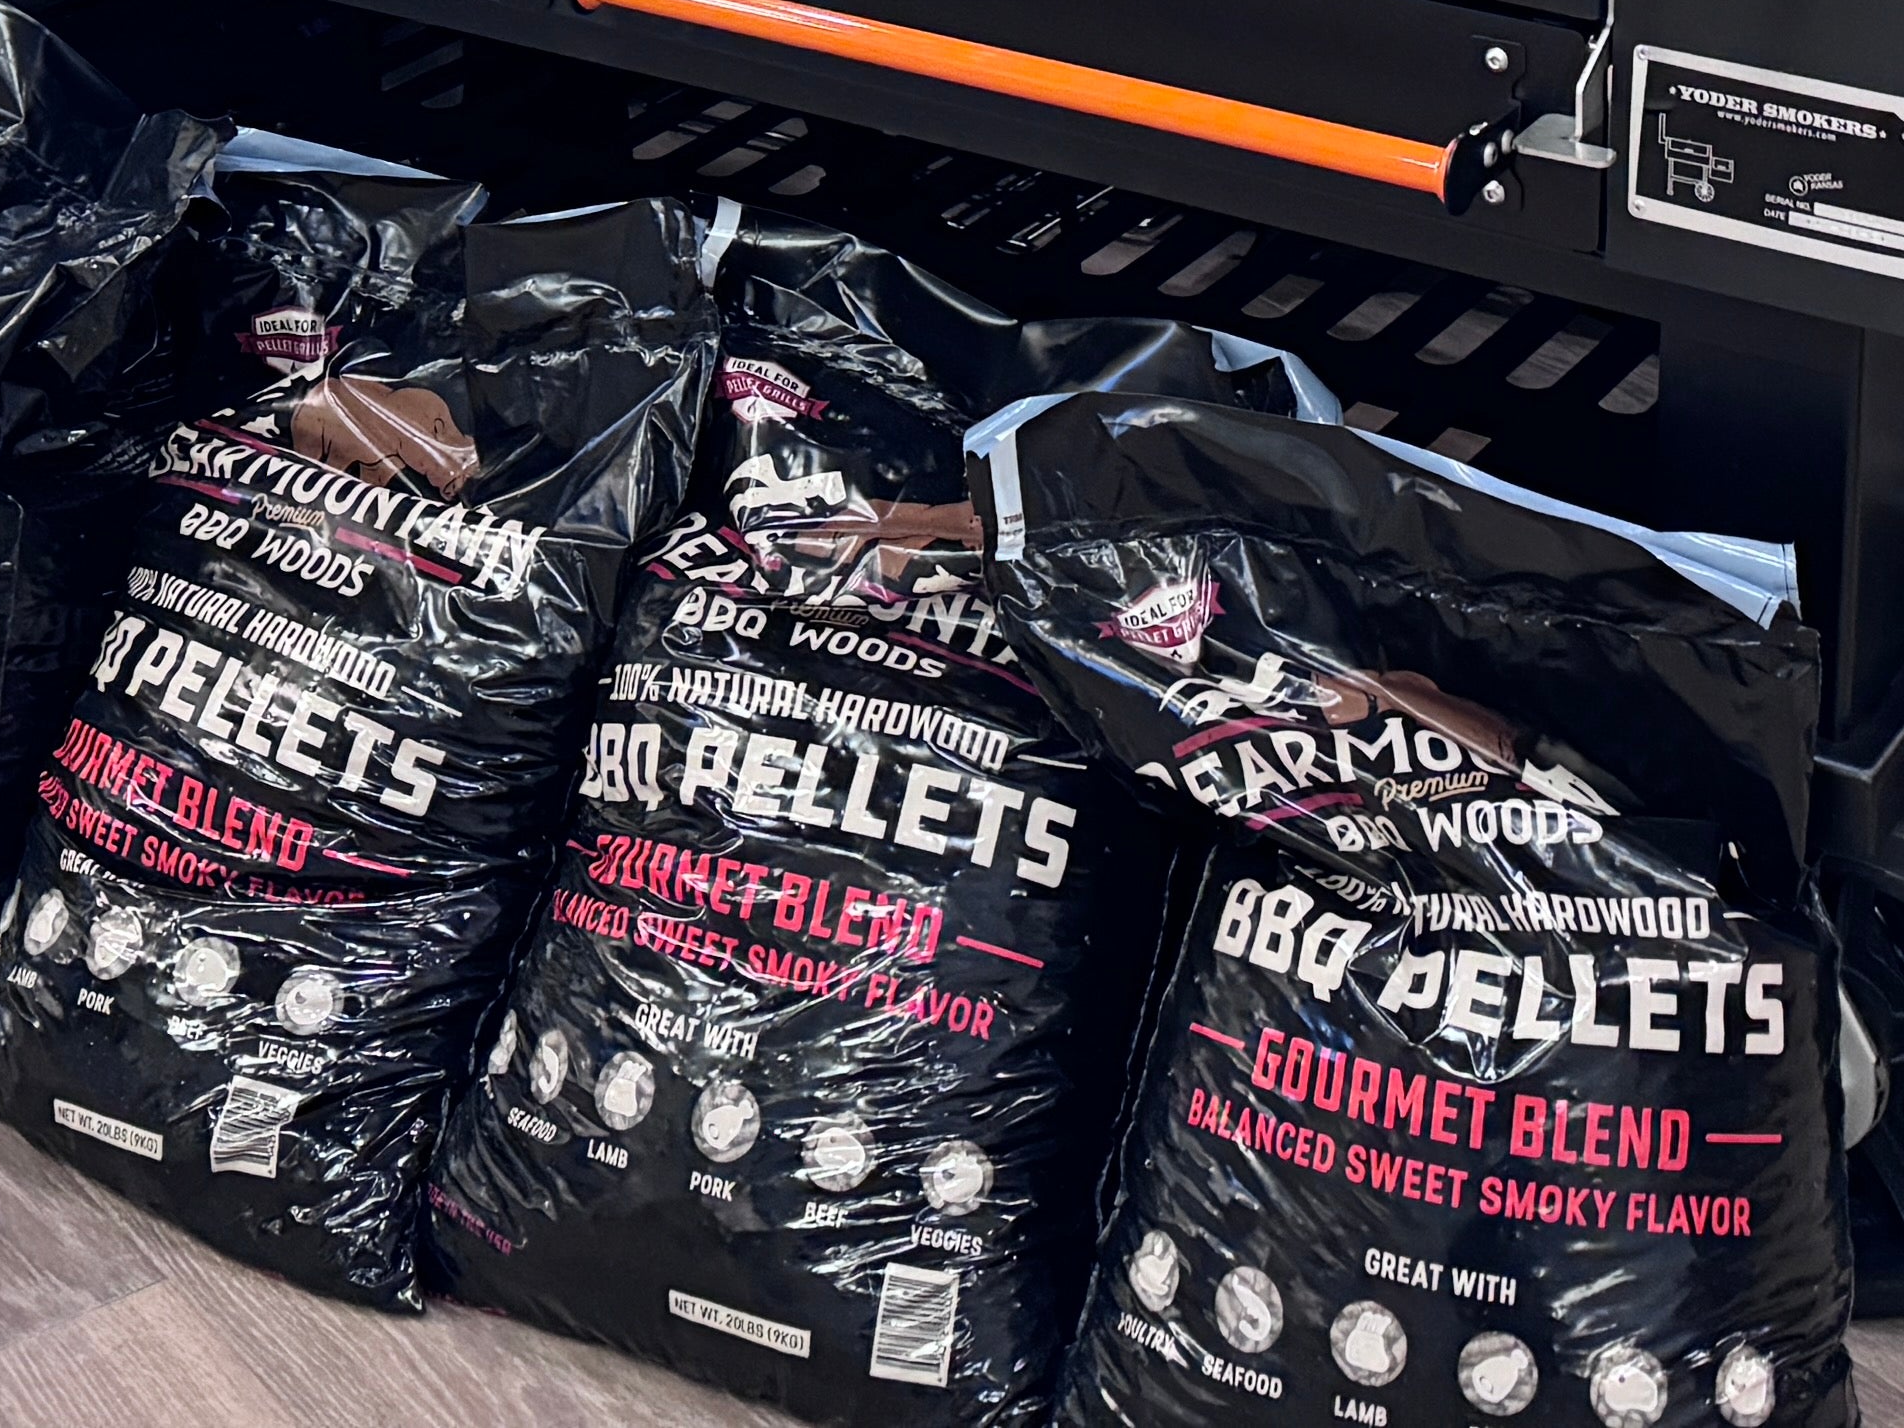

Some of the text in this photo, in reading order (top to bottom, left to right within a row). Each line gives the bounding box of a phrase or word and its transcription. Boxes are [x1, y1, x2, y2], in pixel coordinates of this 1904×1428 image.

[1677, 85, 1877, 139] YODER SMOKERS
[260, 319, 316, 333] IDEAL FOR
[732, 359, 799, 391] IDEAL FOR
[179, 503, 249, 549] BBQ
[250, 493, 326, 530] Premium
[158, 572, 246, 635] NATURAL
[676, 587, 948, 679] BBQ WOODS
[125, 629, 446, 817] PELLETS
[667, 667, 808, 721] NATURAL
[816, 688, 1010, 773] HARDWOOD
[679, 726, 1078, 890] PELLETS
[1374, 768, 1491, 813] Premium
[66, 798, 138, 854] SWEET
[173, 780, 315, 872] BLEND
[1418, 800, 1604, 847] WOODS
[772, 872, 944, 965] BLEND
[1212, 877, 1371, 1002] BBQ
[1378, 947, 1786, 1056] PELLETS
[77, 988, 113, 1015] PORK
[635, 1003, 700, 1044] GREAT
[864, 972, 995, 1041] FLAVOR
[1251, 1027, 1690, 1171] GOURMET BLEND
[507, 1107, 558, 1143] SEAFOOD
[587, 1141, 629, 1169] LAMB
[1187, 1088, 1751, 1237] BALANCED SWEET SMOKY FLAVOR
[690, 1171, 736, 1202] PORK
[804, 1201, 849, 1229] BEEF
[909, 1224, 984, 1256] VEGGIES
[1364, 1248, 1517, 1306] GREAT WITH
[1201, 1353, 1283, 1400] SEAFOOD
[1333, 1395, 1388, 1428] LAMB
